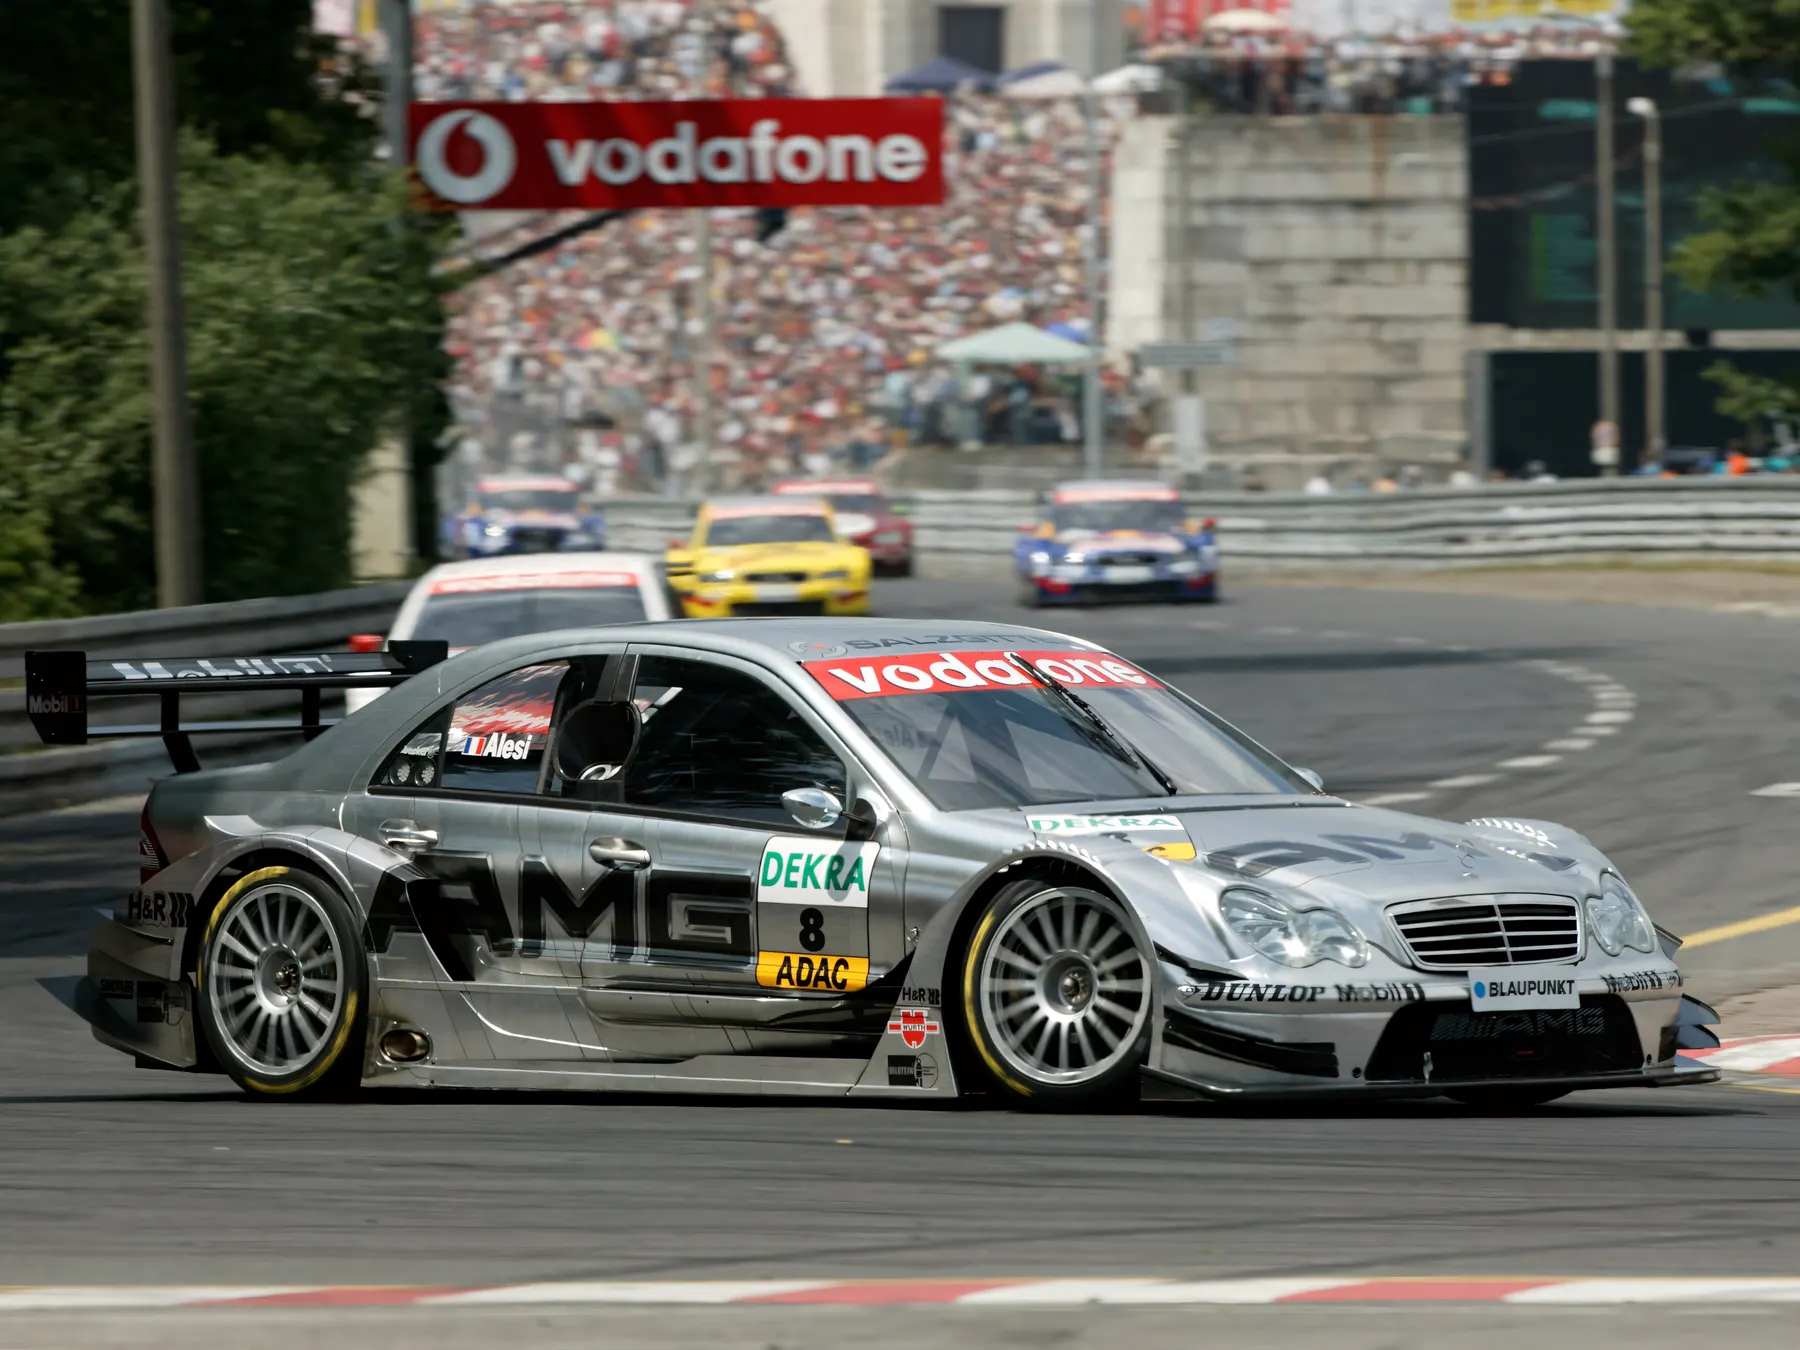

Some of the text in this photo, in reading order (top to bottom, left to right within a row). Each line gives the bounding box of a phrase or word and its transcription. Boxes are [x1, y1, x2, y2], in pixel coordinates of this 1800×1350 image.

[546, 120, 927, 186] vodafone
[29, 694, 68, 713] Mobil
[483, 732, 532, 760] Alesi
[1030, 815, 1178, 831] DEKRA
[761, 851, 866, 892] DEKRA
[129, 891, 168, 921] H&R
[363, 850, 753, 968] AMG
[799, 908, 826, 952] 8
[776, 956, 850, 990] ADAC
[902, 987, 927, 1002] H&R
[1200, 982, 1325, 1002] DUNLOP
[1335, 983, 1400, 1002] Mobil
[1489, 980, 1576, 997] BLAUPUNKT
